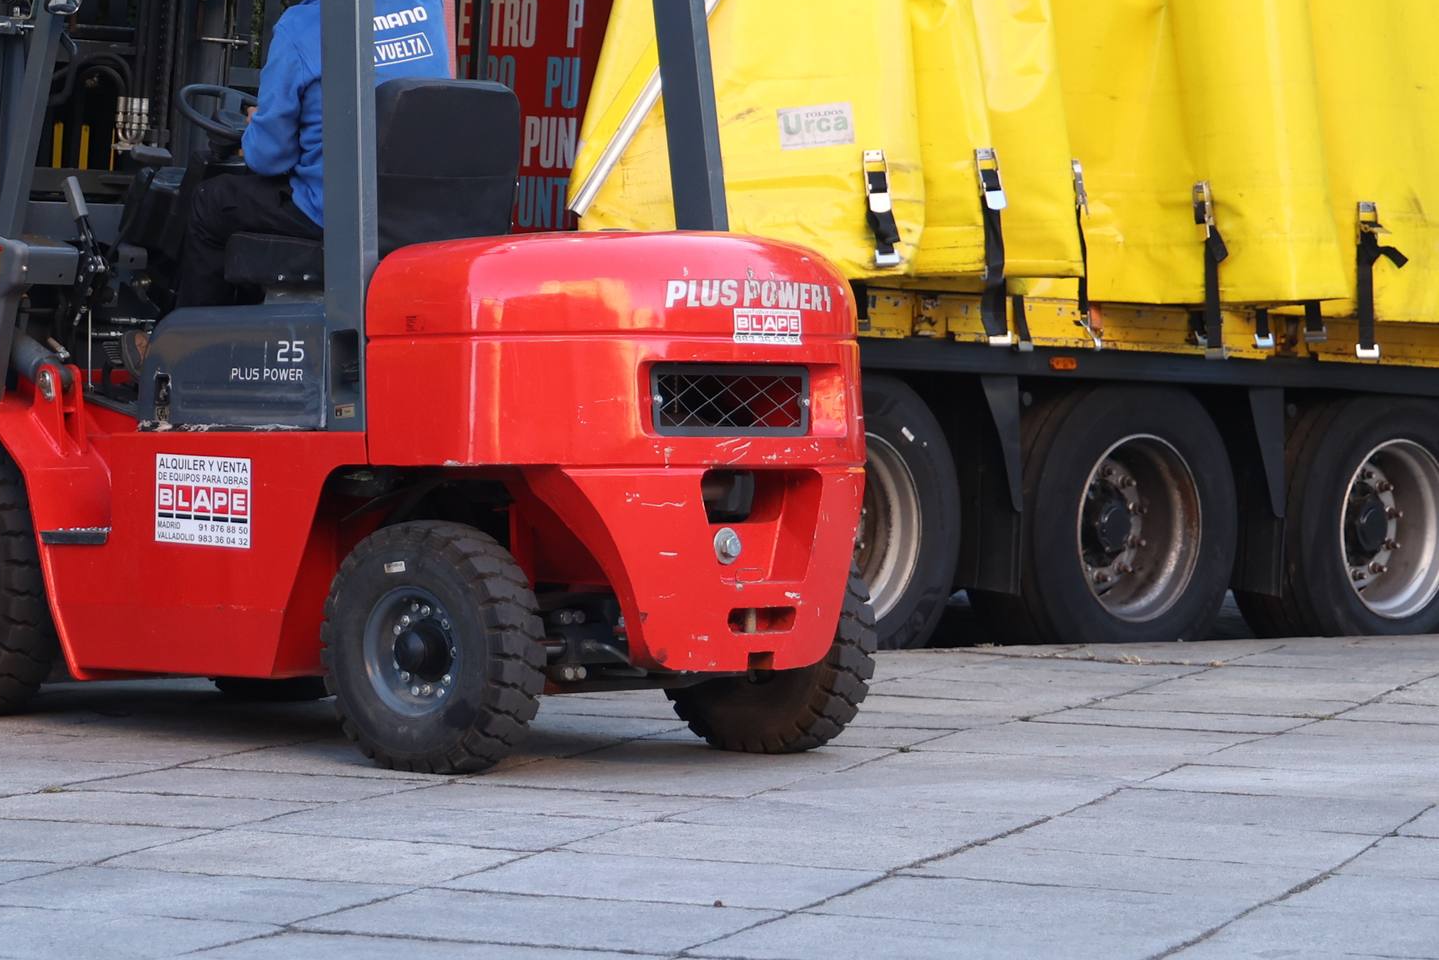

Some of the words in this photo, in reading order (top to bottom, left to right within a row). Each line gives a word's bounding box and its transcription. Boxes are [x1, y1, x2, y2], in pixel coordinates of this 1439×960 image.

[376, 37, 426, 61] VUELTA
[544, 56, 581, 110] PU
[783, 113, 849, 136] Urca
[522, 116, 577, 170] PUN
[664, 279, 738, 308] PLUS
[742, 280, 824, 312] POWER
[737, 316, 799, 330] BLAPE
[276, 340, 305, 362] 25
[231, 368, 260, 381] PLUS
[263, 368, 303, 382] POWER
[159, 457, 206, 471] ALQUILER
[208, 460, 214, 471] Y
[216, 461, 248, 473] VENTA
[158, 471, 168, 481] DE
[169, 472, 200, 483] EQUIPOS
[202, 474, 221, 484] PARA
[223, 475, 249, 486] OBRAS
[159, 488, 247, 511] BLAPE
[157, 520, 181, 530] MADRID
[198, 523, 208, 531] 91
[210, 524, 225, 532] 876
[238, 527, 248, 535] 50
[157, 531, 195, 542] VALLADOLID
[198, 535, 213, 543] 983
[215, 536, 224, 544] 36
[226, 537, 236, 545] 04
[238, 538, 248, 546] 32
